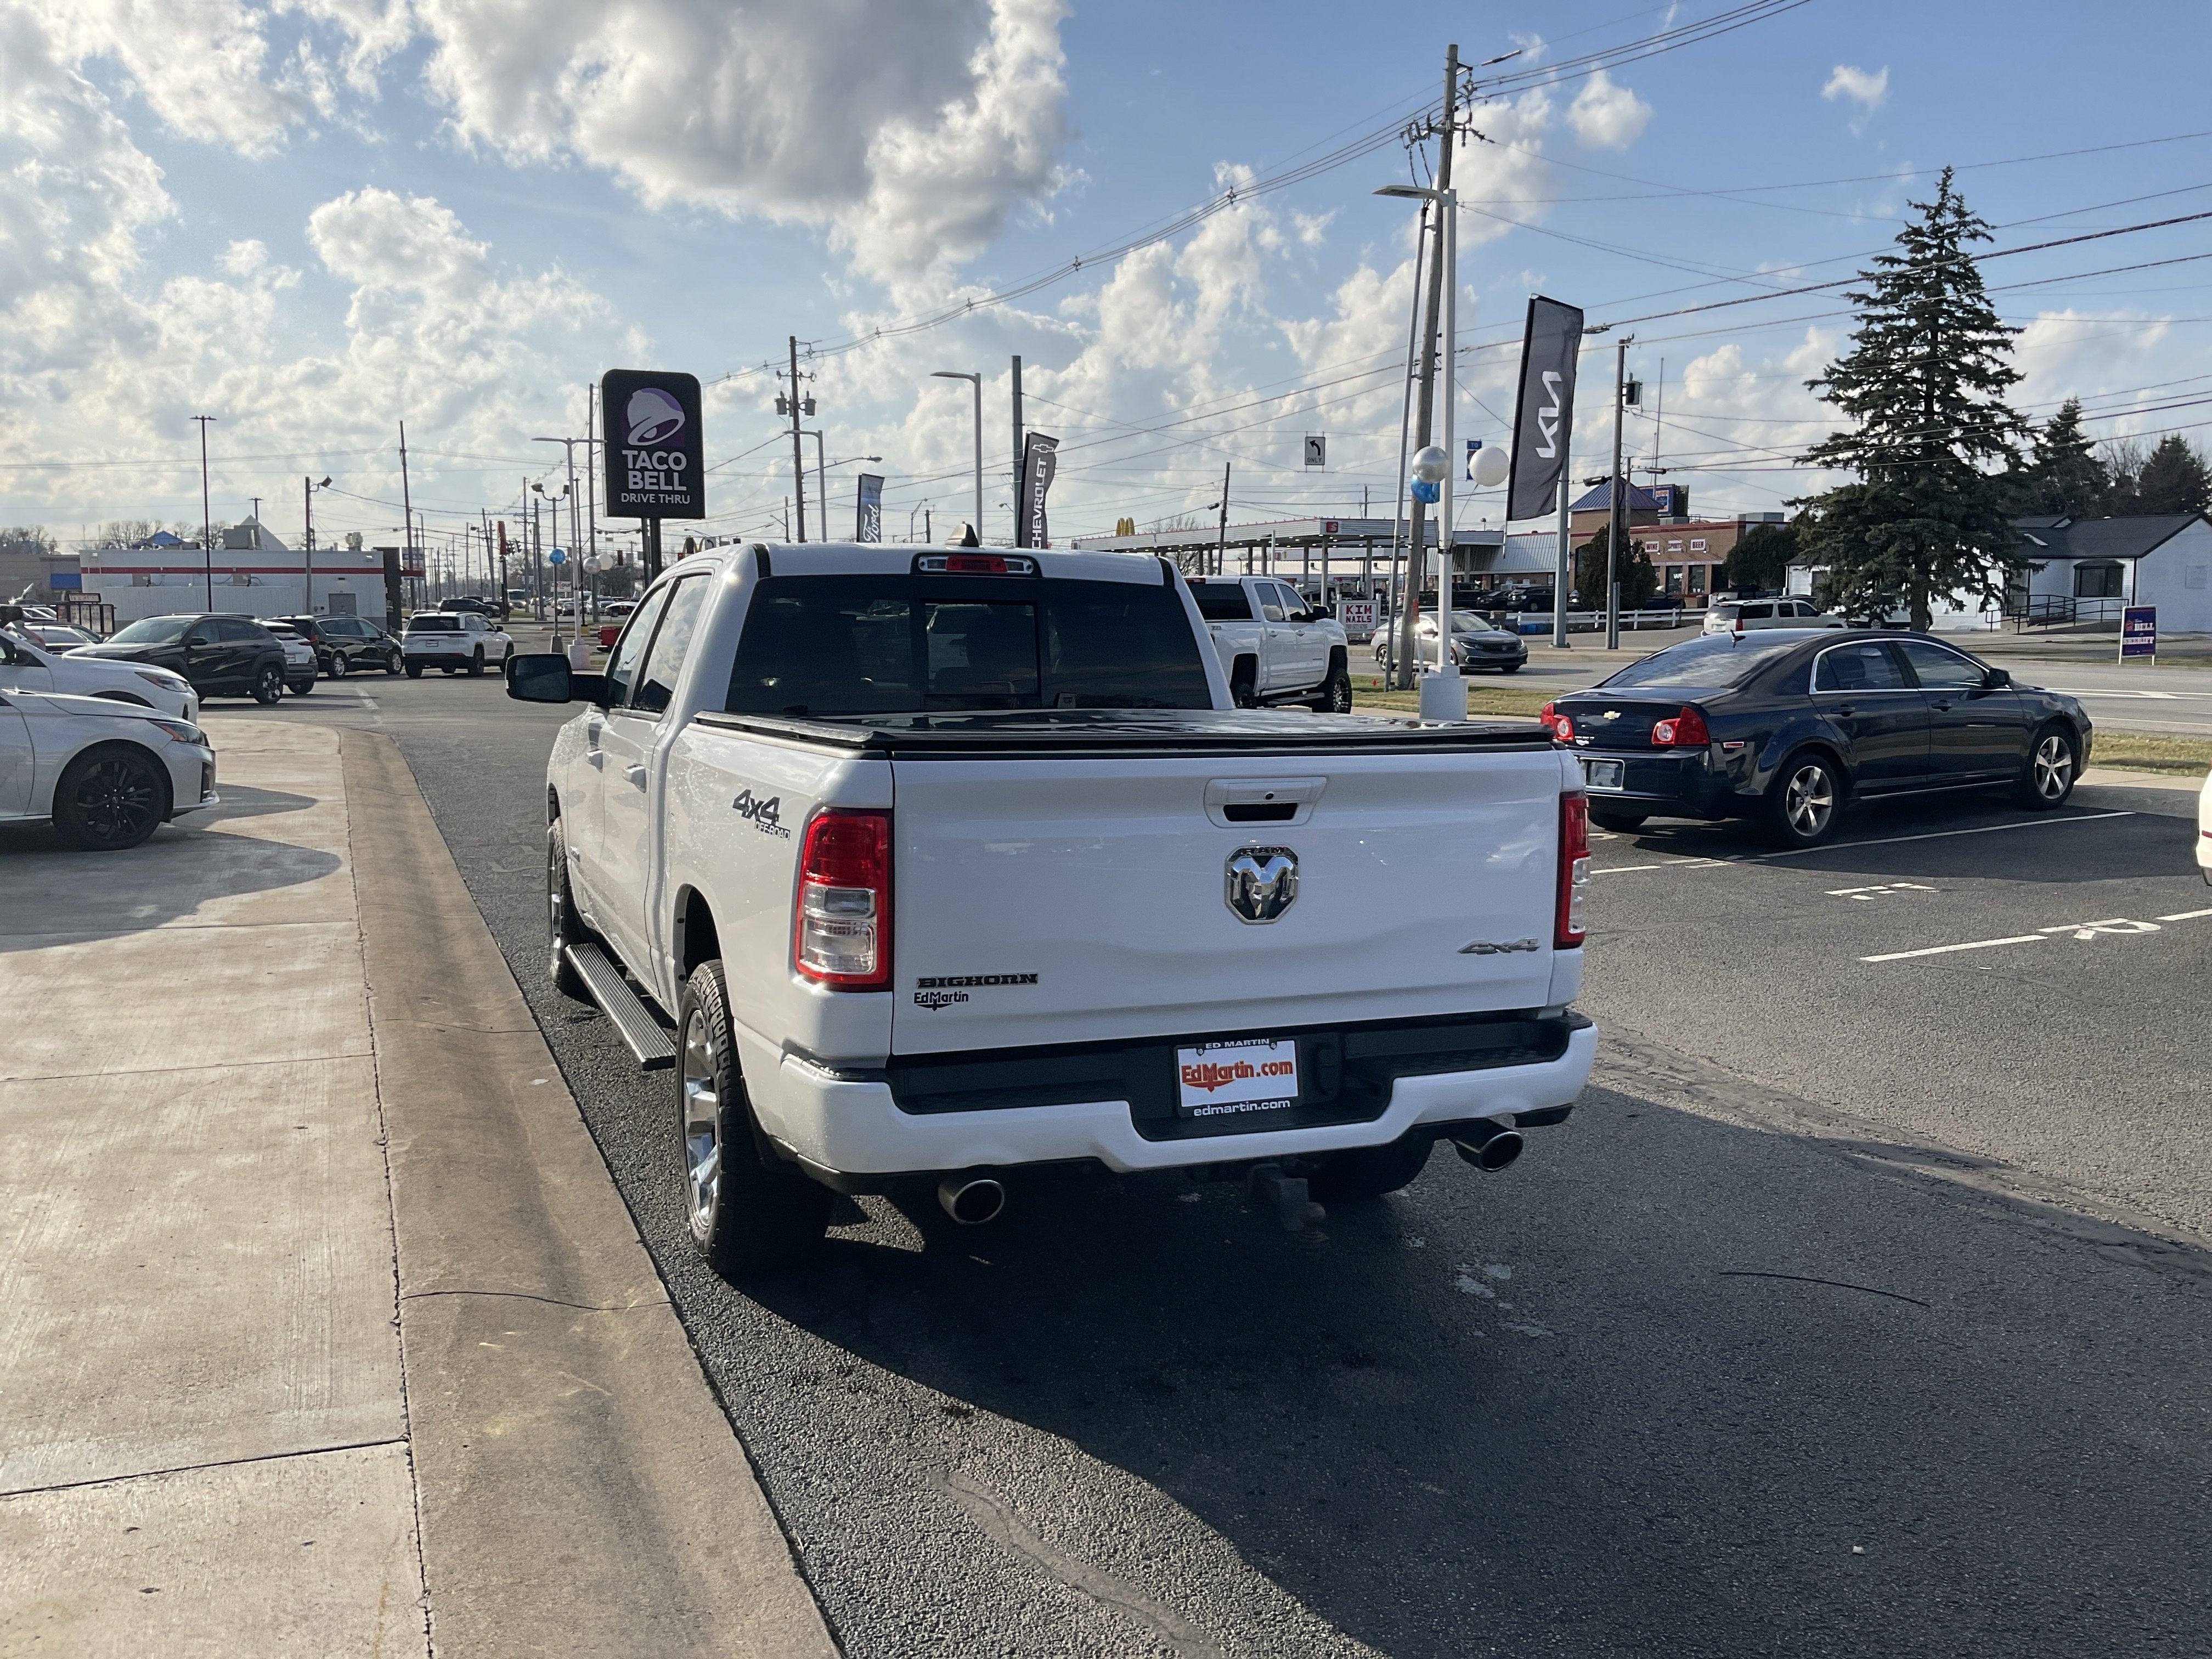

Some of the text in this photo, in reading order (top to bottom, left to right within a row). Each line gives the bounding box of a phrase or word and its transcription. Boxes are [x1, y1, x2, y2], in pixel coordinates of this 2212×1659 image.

[622, 450, 687, 471] TACO
[628, 471, 687, 491] BELL
[621, 493, 691, 504] DRIVE THRU
[1031, 457, 1047, 549] CHEVROLET
[863, 503, 879, 543] Ford
[1346, 605, 1373, 614] KIM
[732, 788, 780, 825] 4x4
[917, 973, 1039, 989] BIGHORN
[1224, 1038, 1270, 1048] MARTIN
[1193, 1099, 1291, 1117] edmartin.com
